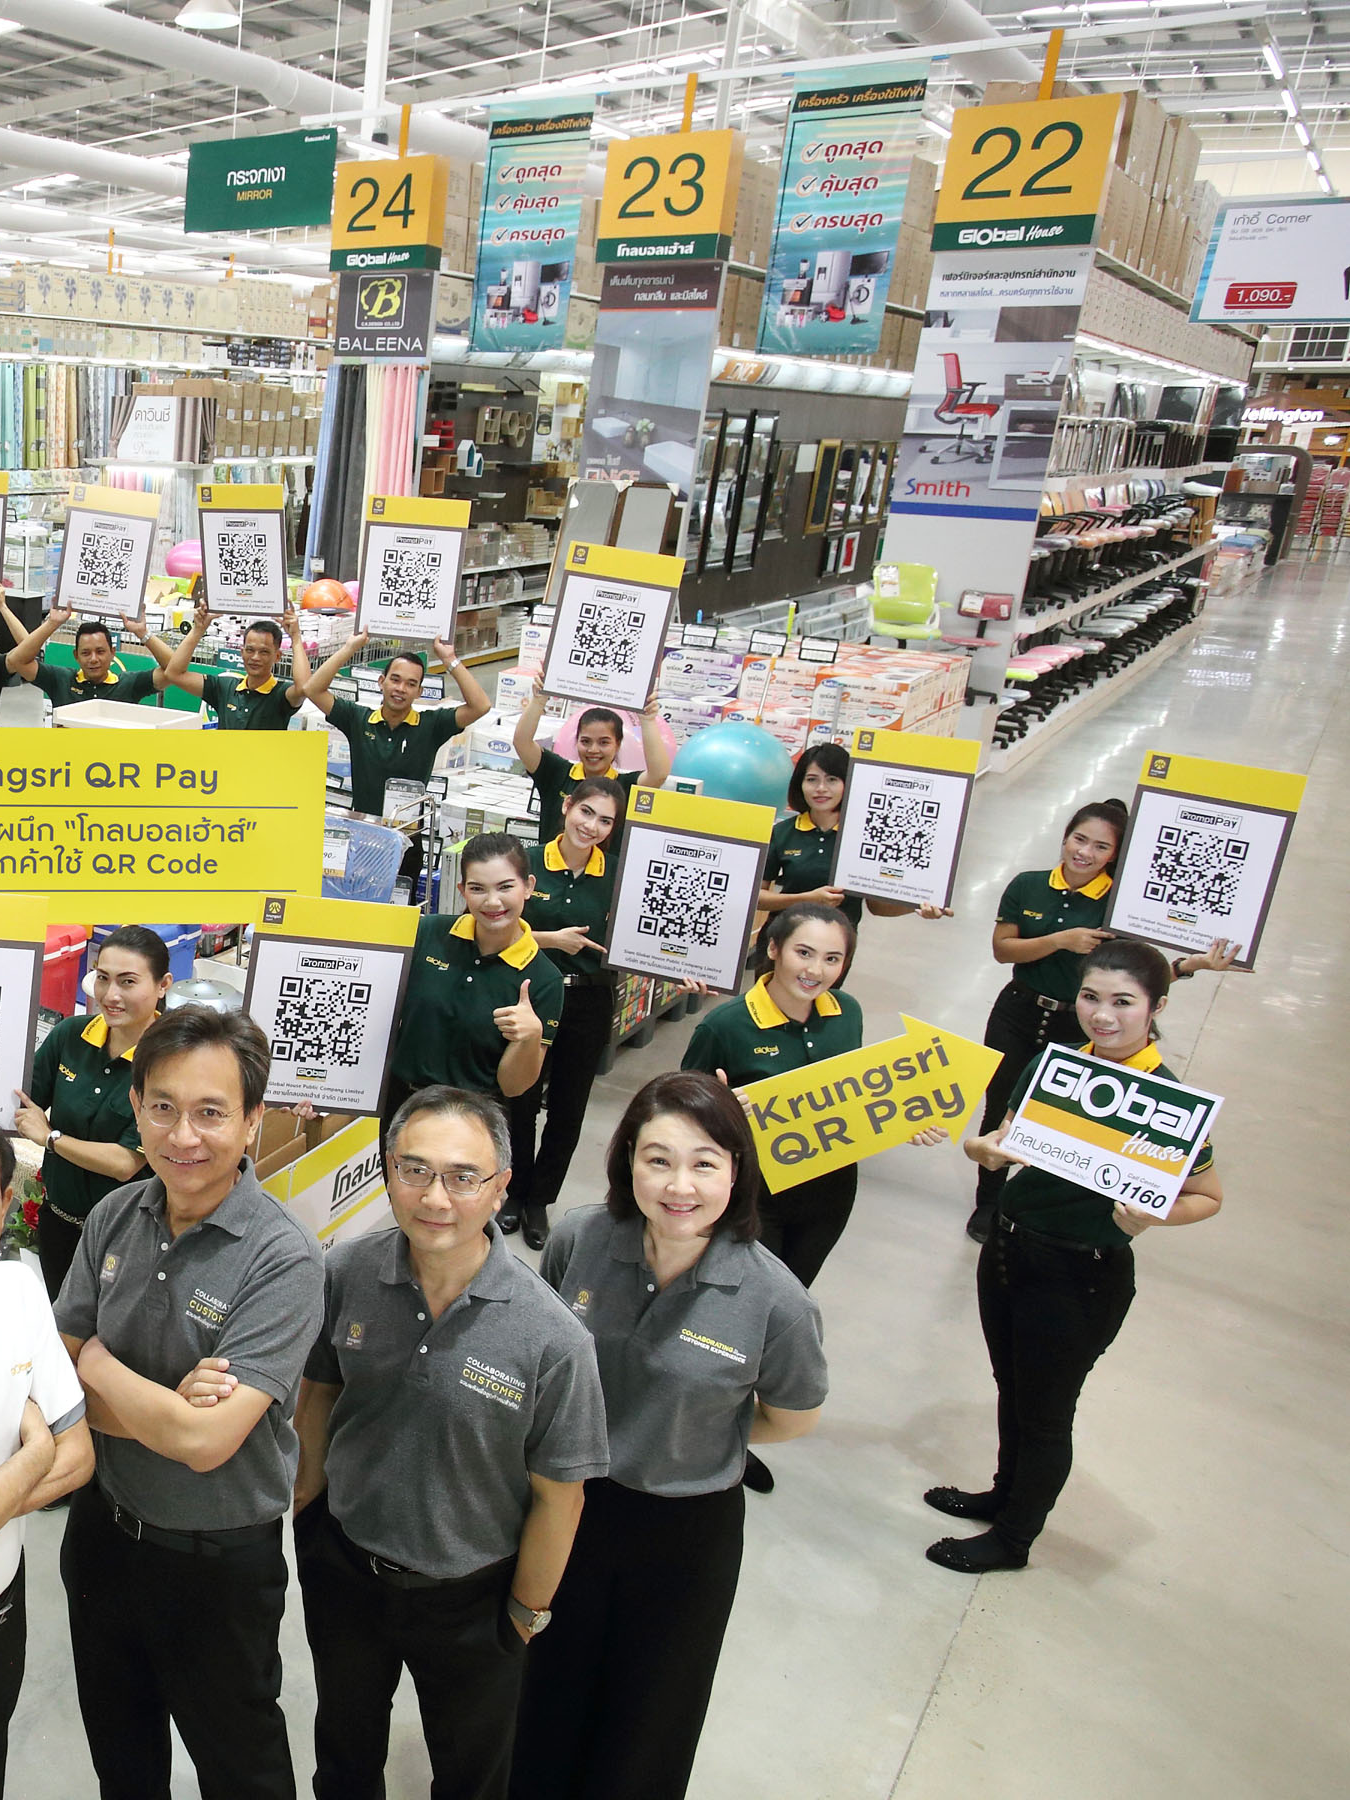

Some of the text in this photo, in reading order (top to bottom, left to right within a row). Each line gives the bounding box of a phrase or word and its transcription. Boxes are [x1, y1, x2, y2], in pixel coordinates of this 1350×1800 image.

[797, 82, 925, 110] เครื่องครัว เครื่องใช้ไฟฟ้า
[493, 115, 592, 137] เครื่องครัว เครื่องใช้ไฟฟ้า
[824, 139, 884, 164] ถูกสุด
[961, 121, 1084, 200] 22
[226, 164, 286, 187] กระจกเงา
[515, 163, 562, 184] ถูกสุด
[819, 173, 879, 195] คุ้มสุด
[236, 189, 273, 202] MIRROR
[618, 153, 706, 219] 23
[348, 173, 416, 232] 24
[513, 193, 560, 214] คุ้มสุด
[814, 211, 884, 236] ครบสุด
[1233, 213, 1259, 226] เก้าอี้
[509, 226, 566, 247] ครบสุด
[958, 224, 1064, 246] Global House
[617, 240, 694, 258] โกลบอลเฮ้าส์
[346, 252, 388, 269] Global
[942, 268, 1076, 285] เฟอร์นิเจอร์และอุปกรณ์สำนักงาน
[634, 289, 666, 303] กลมกลืน
[1237, 289, 1291, 303] 1,090.-
[338, 336, 424, 352] BALEENA
[906, 480, 970, 498] Smith
[596, 590, 638, 604] PromptPay
[683, 664, 694, 674] 2
[841, 692, 850, 703] 2
[84, 761, 141, 789] QR
[155, 762, 219, 795] Pay
[1180, 810, 1238, 829] PromptPay
[92, 853, 136, 875] QR
[148, 853, 219, 875] Code
[666, 844, 718, 862] PromptPay
[301, 957, 358, 972] PromptPay
[297, 1068, 327, 1079] Global
[751, 1036, 949, 1131] Krungsri
[319, 1085, 344, 1094] Company
[345, 1087, 365, 1095] Limited
[1040, 1057, 1208, 1142] Global
[770, 1082, 966, 1165] QR Pay
[1010, 1126, 1093, 1171] โกลบอลเฮ้าส์
[1120, 1131, 1185, 1163] House
[1139, 1176, 1161, 1190] Center
[1119, 1181, 1167, 1209] 1160
[679, 1334, 746, 1364] CUSTOMER EXPERIENCE
[681, 1328, 734, 1353] COLLABORATING
[466, 1356, 526, 1389] COLLABORATING
[462, 1368, 523, 1402] CUSTOMER
